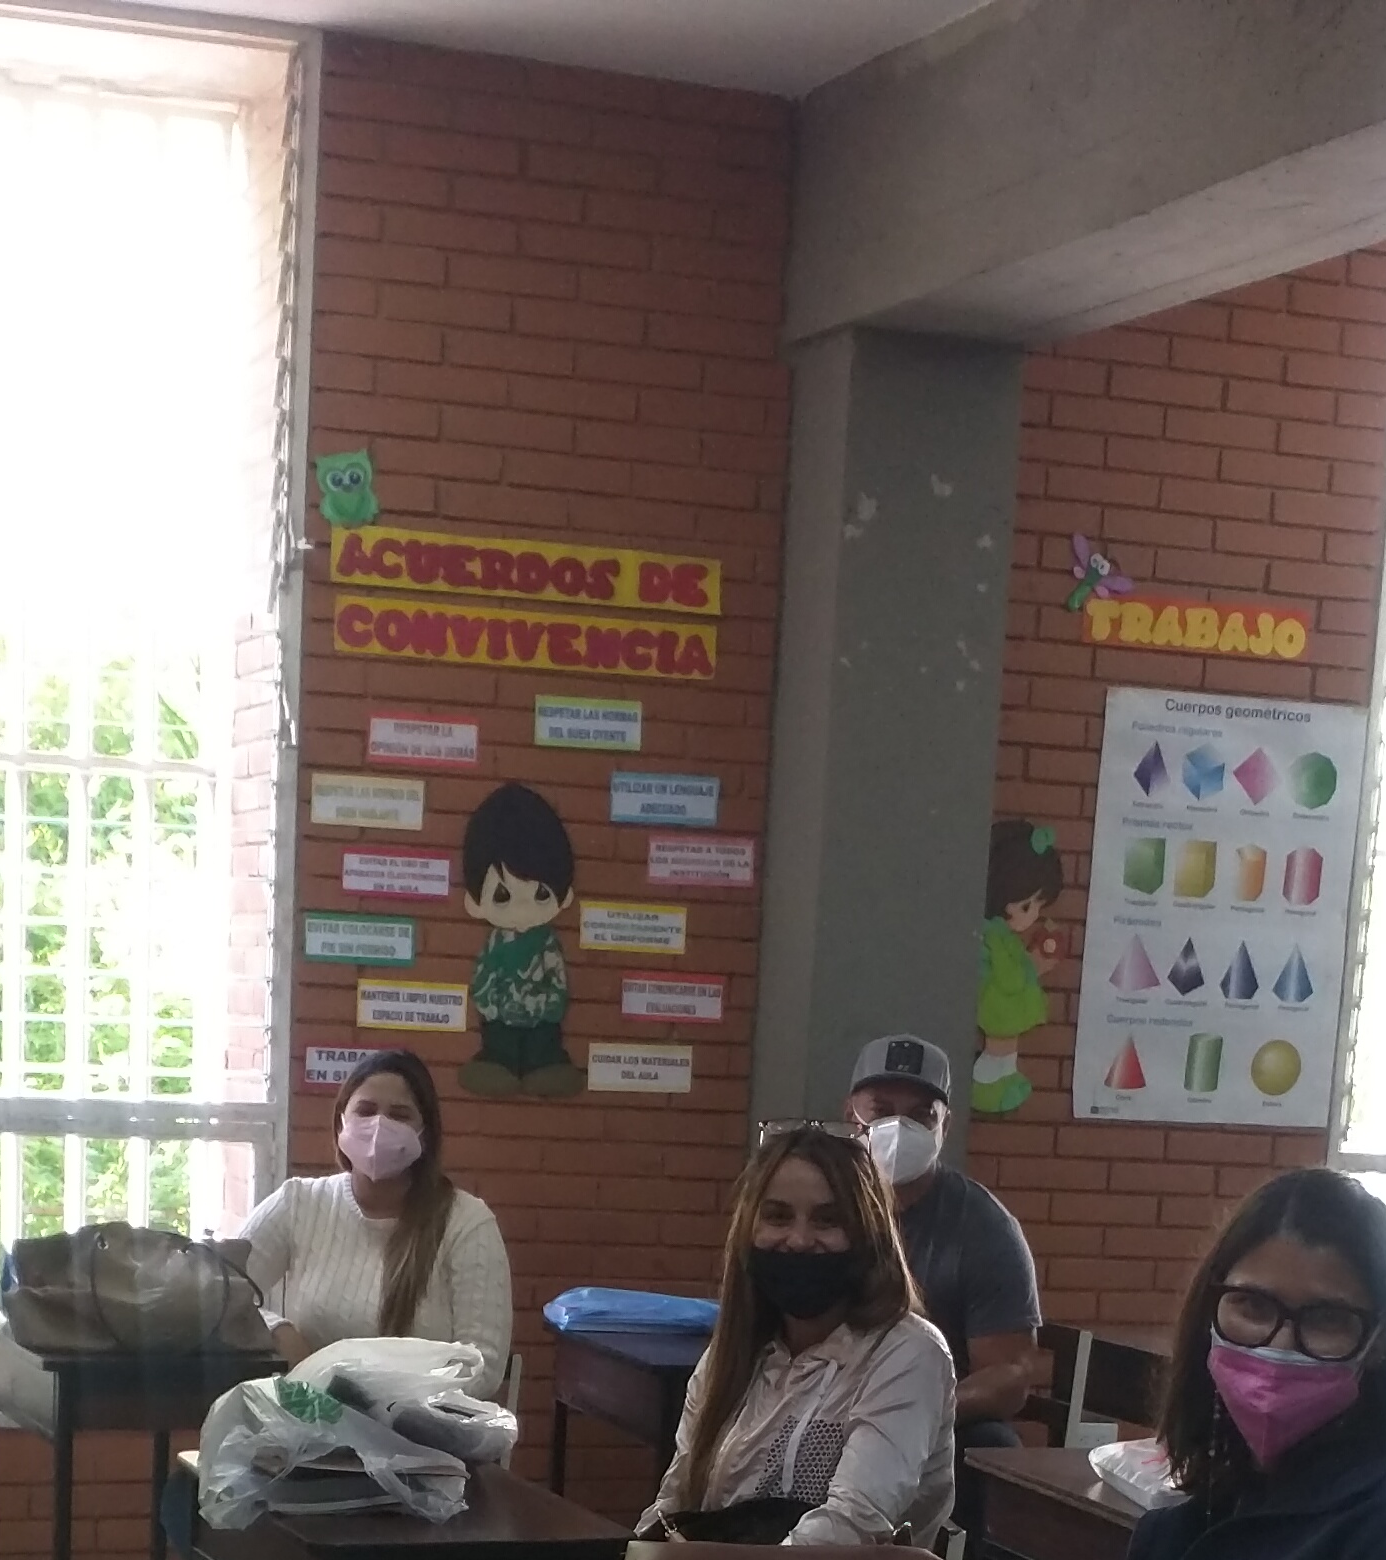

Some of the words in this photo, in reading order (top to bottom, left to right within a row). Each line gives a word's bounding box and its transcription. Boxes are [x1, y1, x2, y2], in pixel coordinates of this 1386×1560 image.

[336, 533, 620, 600] ACUERDOS
[638, 561, 709, 607] DE
[336, 604, 713, 676] CONVIVENCIA
[1085, 599, 1307, 660] TRABAJO
[1165, 698, 1222, 717] Cuerpos
[416, 1012, 449, 1024] TRABAJO
[306, 1070, 327, 1081] EN
